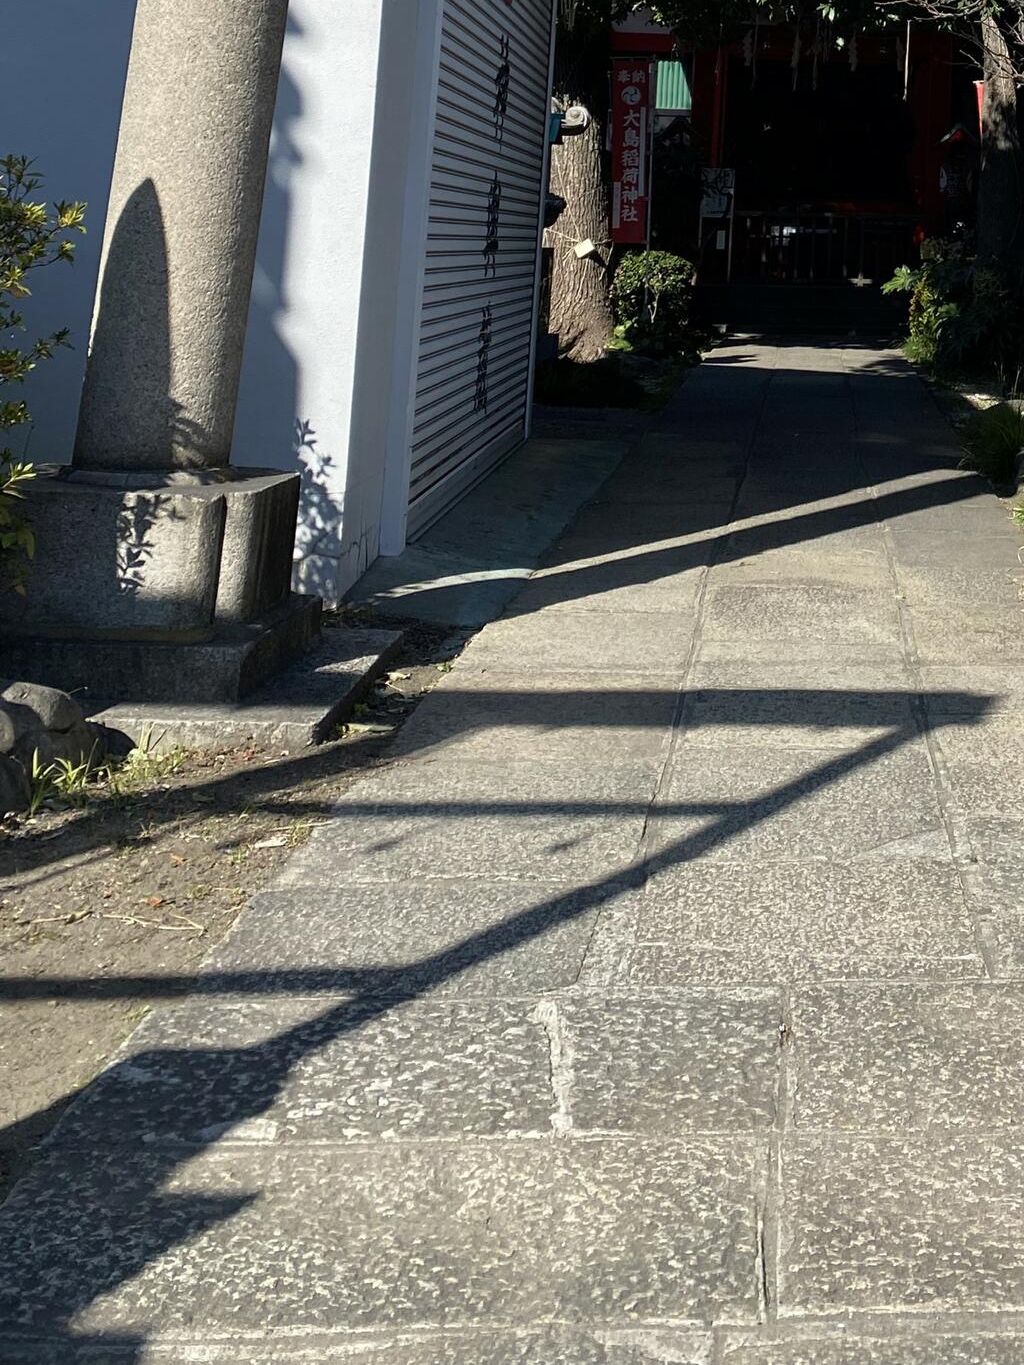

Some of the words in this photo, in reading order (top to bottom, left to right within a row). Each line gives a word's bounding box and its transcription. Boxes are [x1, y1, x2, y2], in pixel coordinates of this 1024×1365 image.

[617, 69, 646, 84] 奉納
[621, 108, 641, 222] 大島稲荷神社
